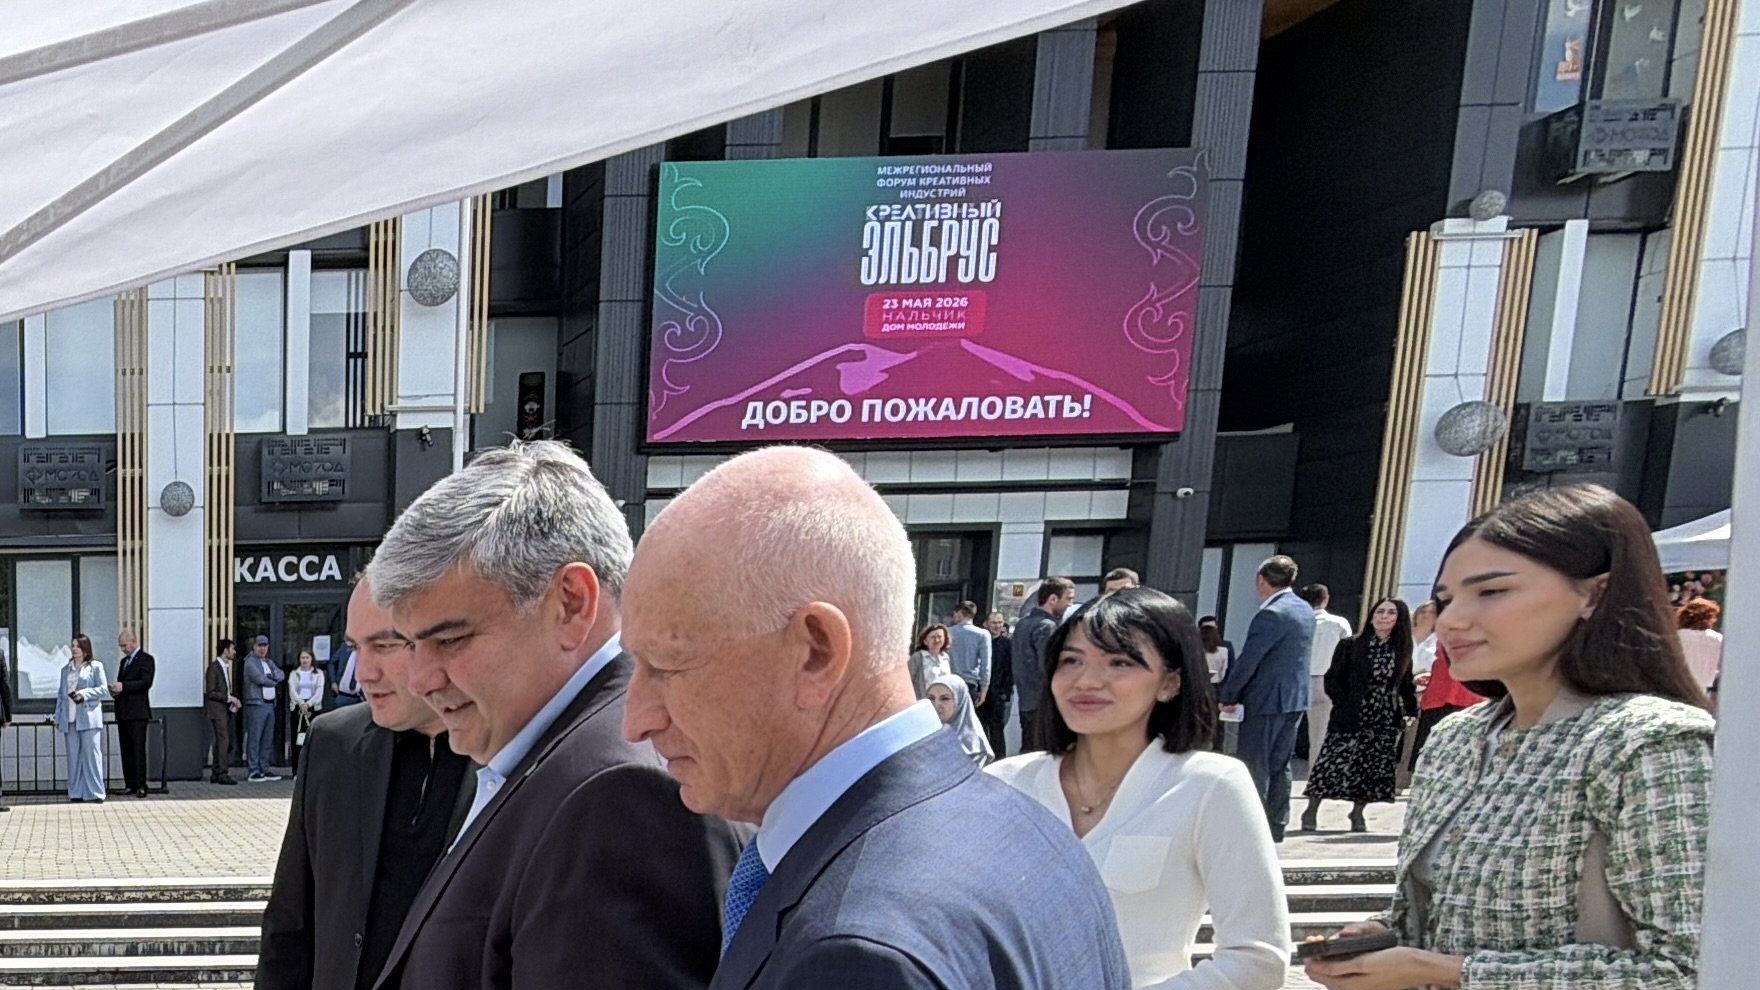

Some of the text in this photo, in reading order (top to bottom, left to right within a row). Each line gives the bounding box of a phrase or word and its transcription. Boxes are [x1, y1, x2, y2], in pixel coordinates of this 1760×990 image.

[877, 162, 993, 176] МЕЖРЕГИОНАЛЬНЫЙ
[876, 175, 991, 188] ФОРУМ КРЕАТИВНЫХ
[900, 187, 966, 199] ИНДУСТРИЙ
[866, 199, 1001, 220] КРЕАТИВНЫЙ
[860, 217, 1000, 285] ЭЛЬБРУС
[882, 297, 968, 309] 23 МАЯ 2026
[882, 310, 967, 322] НАЛЬЧИК
[881, 323, 905, 333] ДОМ
[741, 394, 1092, 430] ДОБРО ПОЖАЛОВАТЬ!
[234, 555, 342, 582] КАССА
